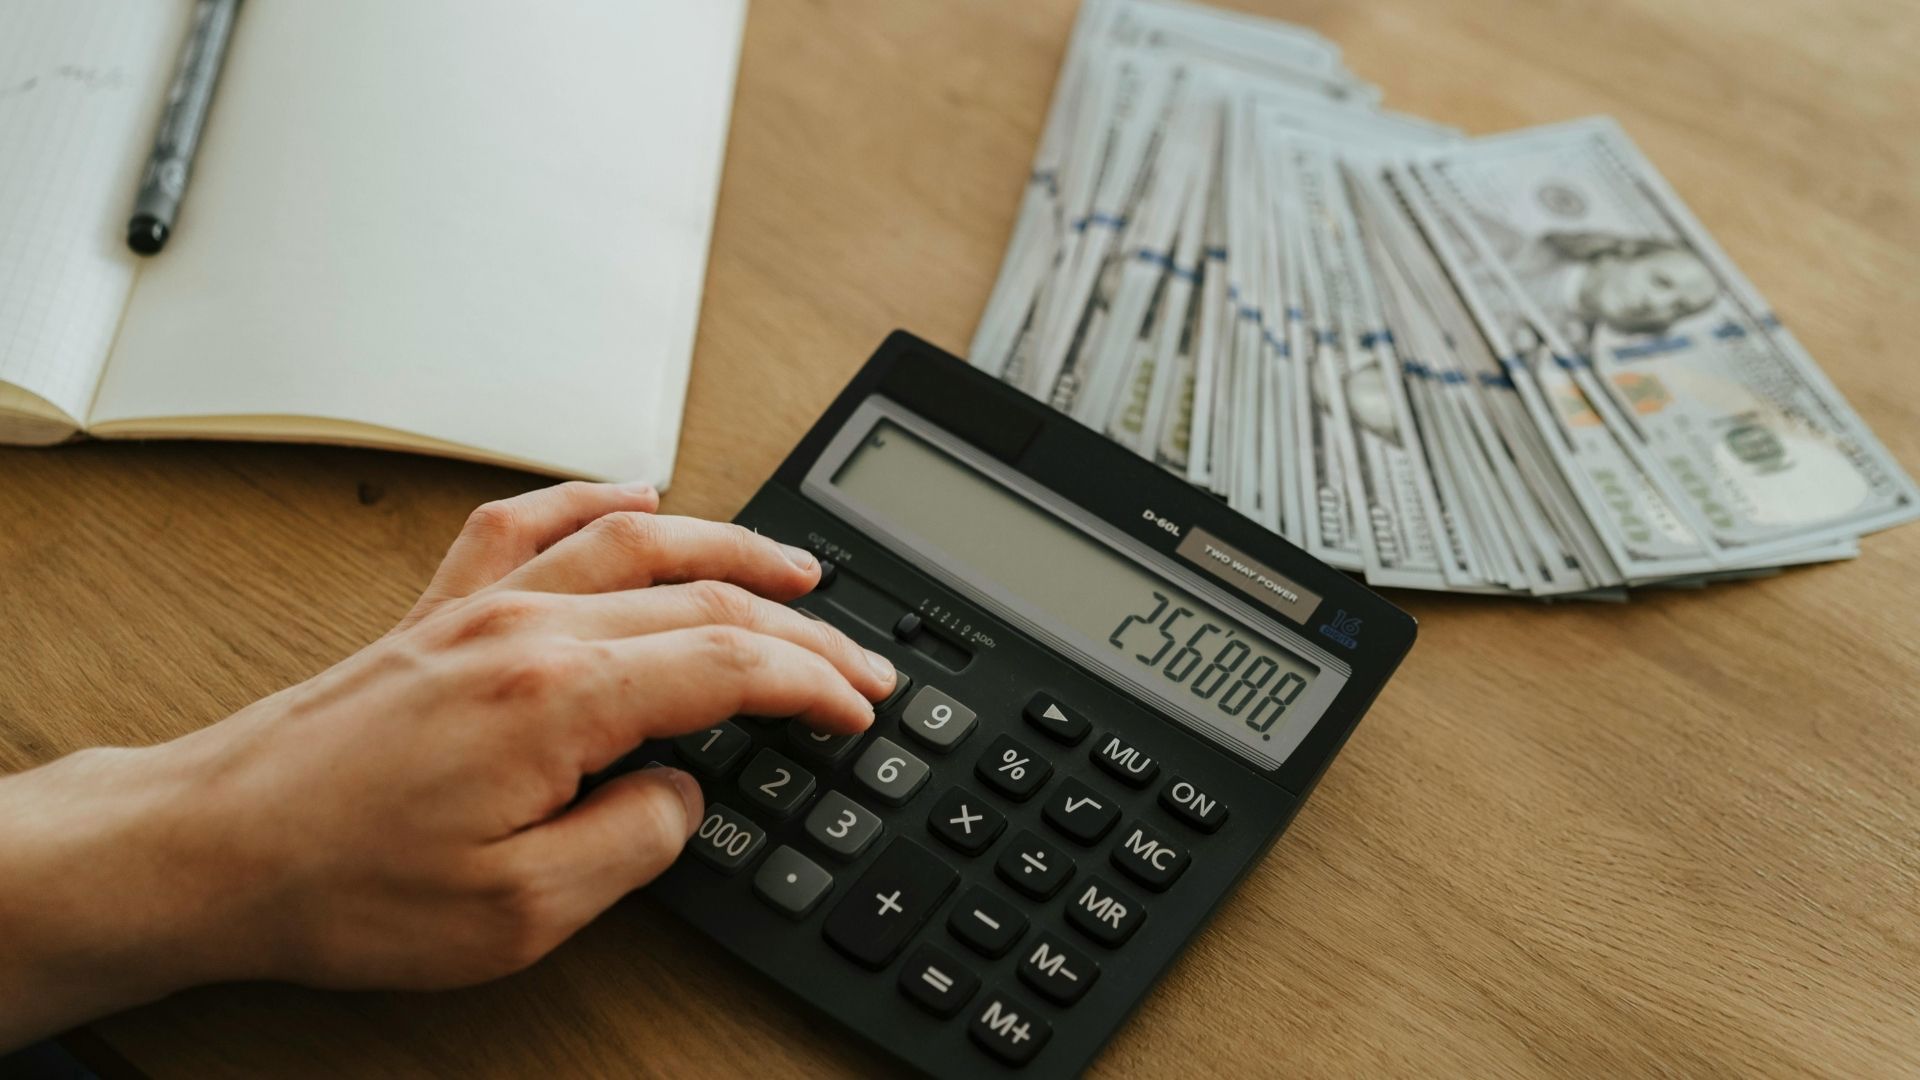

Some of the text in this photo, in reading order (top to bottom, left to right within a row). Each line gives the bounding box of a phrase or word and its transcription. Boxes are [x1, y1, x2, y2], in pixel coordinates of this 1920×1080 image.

[1142, 509, 1180, 537] D-60L
[1204, 544, 1299, 604] TWO WAY POWER
[1331, 609, 1363, 638] 16
[923, 704, 953, 730] 9
[700, 729, 724, 752] 1
[1102, 737, 1152, 774] MU
[876, 757, 907, 783] 6
[998, 749, 1027, 780] %
[759, 767, 791, 798] 2
[1171, 781, 1216, 818] ON
[699, 814, 752, 857] 000
[825, 809, 857, 838] 3
[1124, 828, 1176, 871] MC
[1078, 885, 1127, 929] MR
[1030, 943, 1078, 982] M-
[981, 1001, 1031, 1046] M+
